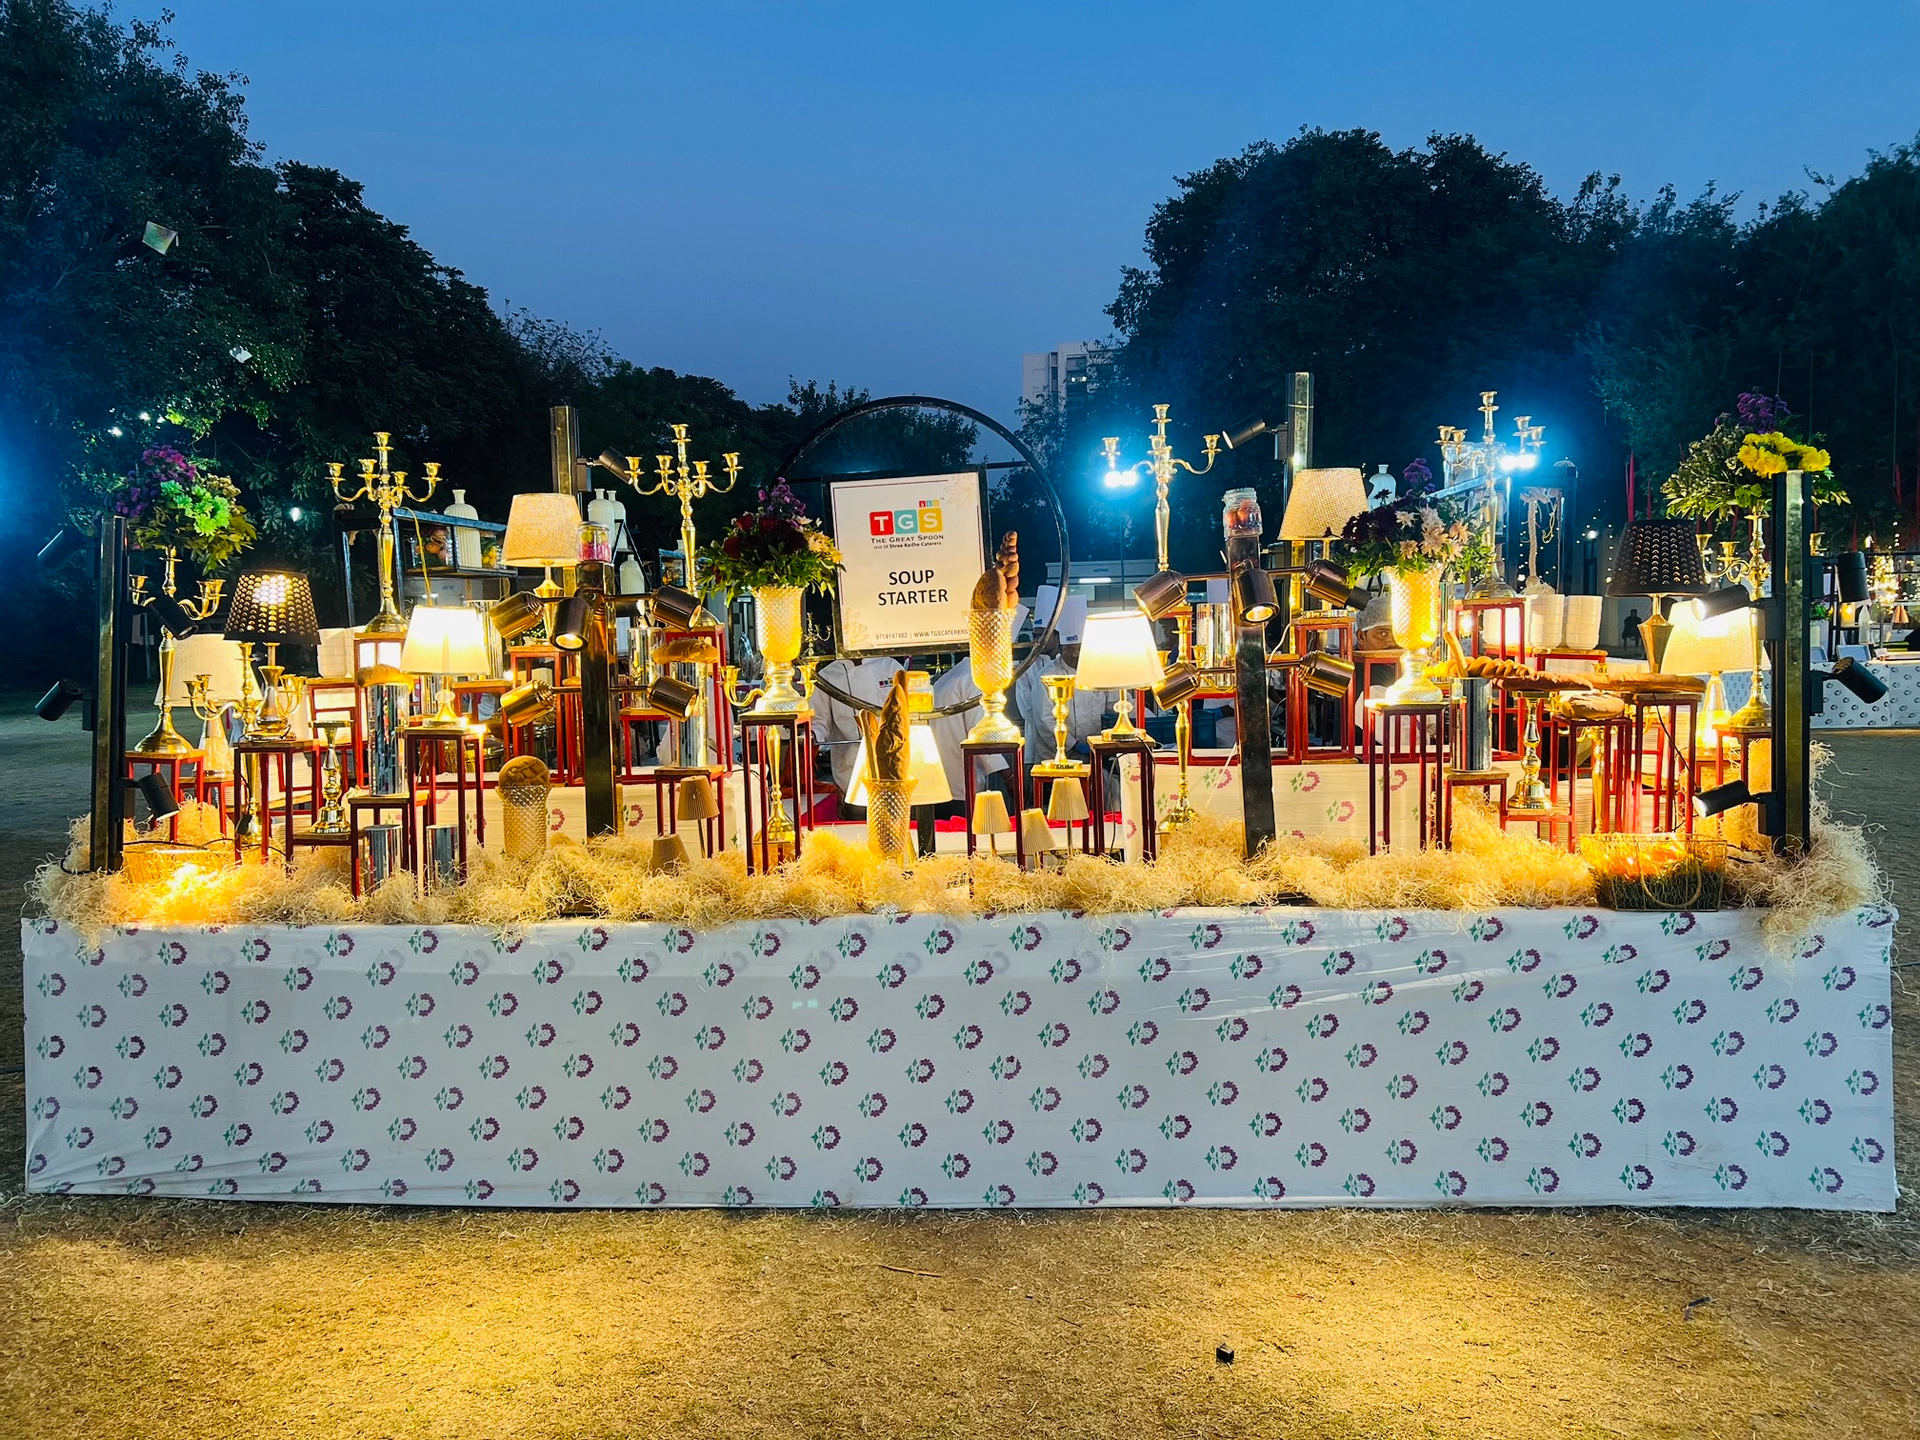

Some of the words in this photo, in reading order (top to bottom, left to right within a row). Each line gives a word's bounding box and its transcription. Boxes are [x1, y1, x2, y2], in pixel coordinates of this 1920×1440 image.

[873, 512, 939, 532] TGS
[888, 569, 935, 586] SOUP
[877, 588, 949, 606] STARTER
